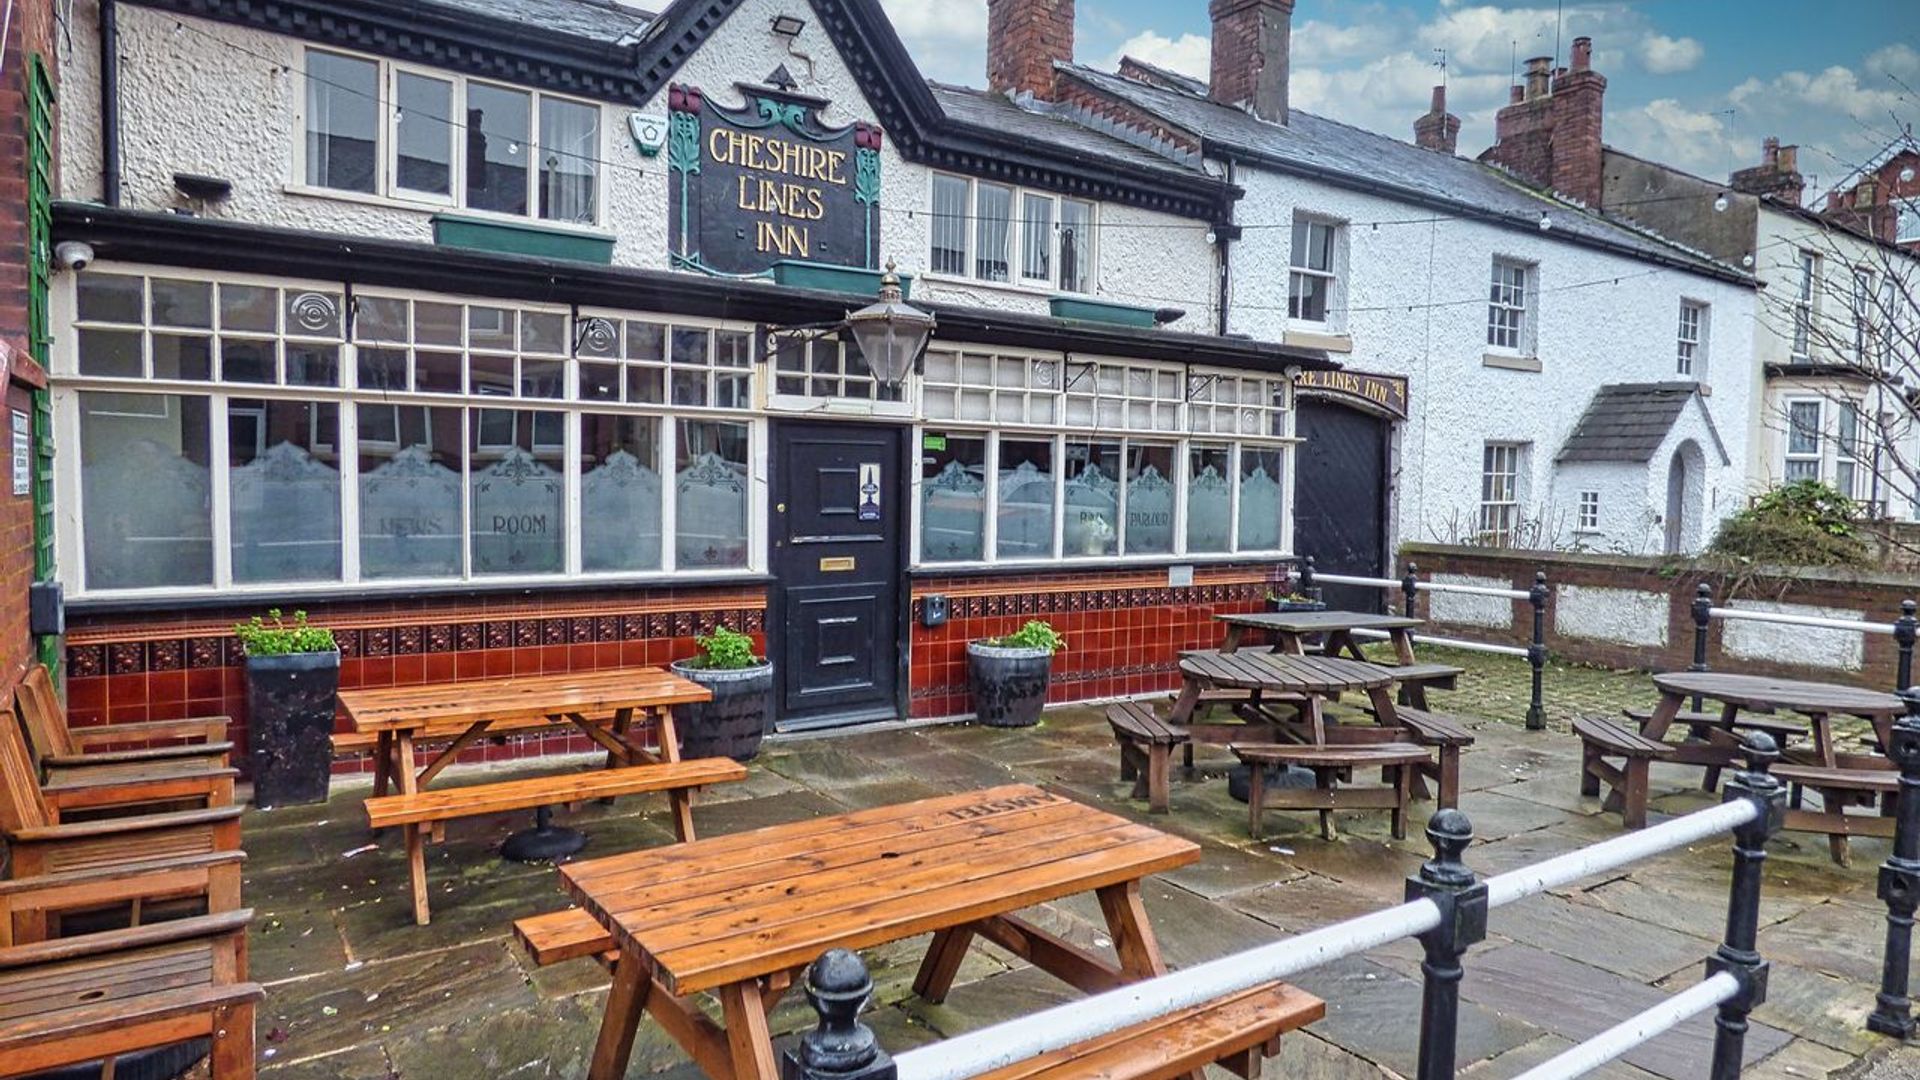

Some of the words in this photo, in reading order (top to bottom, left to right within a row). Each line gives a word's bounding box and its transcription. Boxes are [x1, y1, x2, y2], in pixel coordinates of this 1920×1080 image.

[709, 128, 846, 185] CHESHIRE
[738, 175, 824, 220] LINES
[756, 221, 809, 257] INN
[1323, 372, 1360, 392] LINES
[1365, 379, 1388, 402] INN
[493, 514, 546, 535] ROOM
